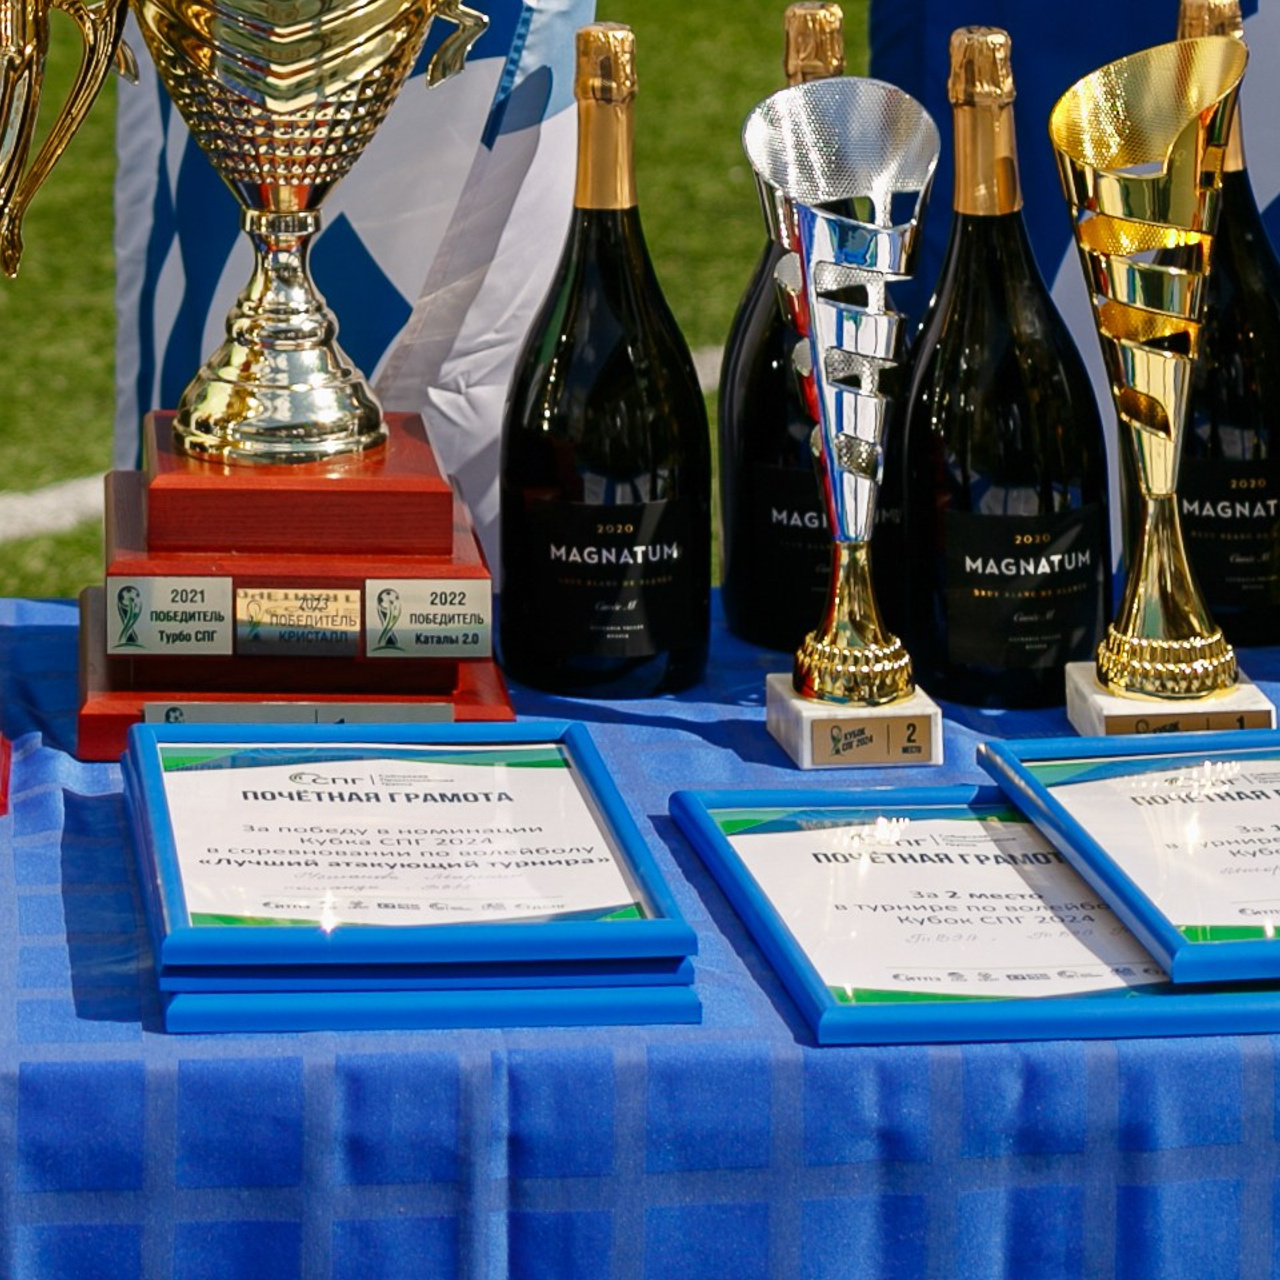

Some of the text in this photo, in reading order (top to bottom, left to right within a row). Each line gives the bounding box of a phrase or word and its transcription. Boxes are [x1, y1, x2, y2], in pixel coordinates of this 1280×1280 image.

[1230, 478, 1267, 489] 2020
[1182, 498, 1279, 518] MAGNAT
[597, 524, 634, 534] 2020
[1014, 534, 1051, 544] 2020
[550, 542, 678, 564] MAGNATUM
[965, 549, 1091, 575] MAGNATUM
[171, 589, 205, 603] 2021
[430, 591, 466, 606] 2022
[298, 597, 329, 612] 2023
[150, 610, 225, 624] ПОБЕДИТЕЛЬ
[270, 614, 357, 628] ПОБЕДИТЕЛЬ
[409, 613, 485, 626] ПОБЕДИТЕЛЬ
[158, 630, 218, 645] Турбо СПГ
[278, 630, 349, 643] КРИСТАЛЛ
[415, 632, 480, 645] Каталы 2.0
[906, 723, 917, 743] 2
[242, 789, 514, 803] ПОЧЁТНАЯ ГРАМОТА
[243, 824, 269, 833] За
[278, 825, 368, 836] победу
[399, 826, 543, 835] номинации
[299, 837, 493, 846] Кубка СПГ 2024
[1200, 836, 1280, 848] урнире
[228, 848, 411, 858] соревновании
[459, 846, 594, 856] волейболу
[199, 857, 610, 869] «Лучший атакующий турнира»
[958, 852, 1067, 866] ГРАМОТ
[912, 890, 1043, 900] За 2 место
[855, 903, 958, 913] турнире
[967, 904, 996, 912] по
[1005, 901, 1110, 912] волейбо
[897, 914, 1096, 926] Кубок СПГ 2024
